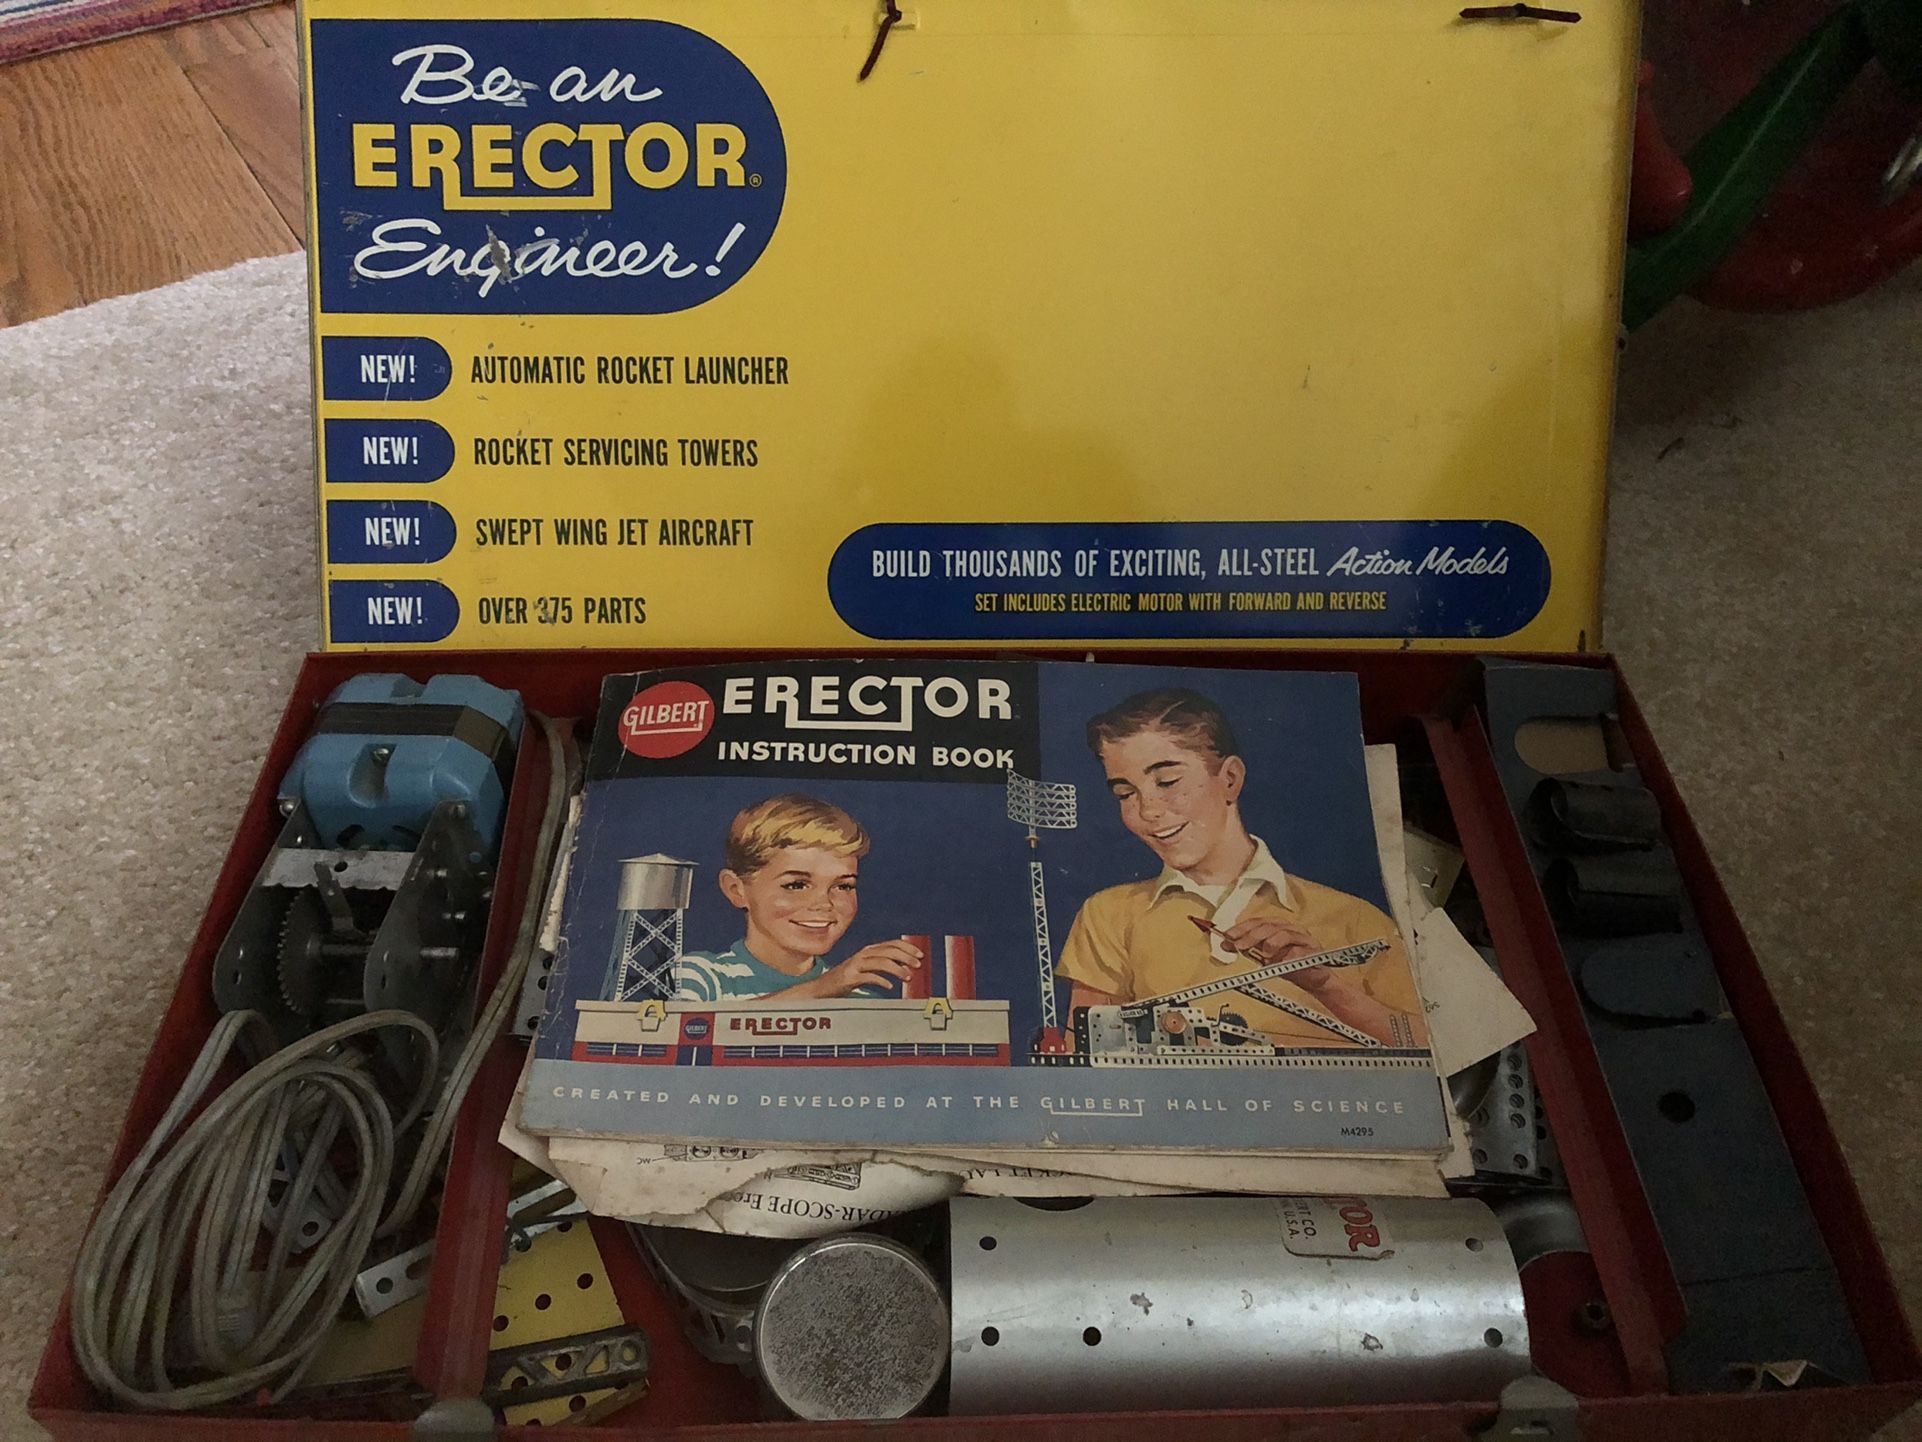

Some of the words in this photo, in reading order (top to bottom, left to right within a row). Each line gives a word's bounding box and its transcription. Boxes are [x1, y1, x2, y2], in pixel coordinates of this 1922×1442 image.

[392, 44, 525, 104] Be
[549, 66, 663, 102] an
[353, 218, 747, 298] Engineer!
[360, 354, 418, 383] NEW!
[471, 356, 586, 384] AUTOMATIC
[597, 356, 674, 385] ROCKET
[684, 356, 790, 385] LAUNCHER
[363, 436, 419, 465] NEW!
[473, 438, 553, 466] ROCKET
[564, 438, 669, 466] SERVICING
[678, 438, 759, 467] TOWERS
[365, 517, 421, 545] NEW!
[475, 518, 544, 546] SWEPT
[554, 518, 608, 546] WING
[617, 518, 649, 546] JET
[658, 518, 754, 546] AIRCRAFT
[872, 550, 931, 577] BUILD
[942, 550, 1062, 577] THOUSANDS
[1074, 549, 1099, 577] OF
[1109, 548, 1206, 580] EXCITING,
[1217, 548, 1320, 576] ALL-STEEL
[1326, 545, 1413, 577] Action
[1415, 545, 1510, 576] Models
[367, 597, 423, 625] NEW!
[478, 598, 528, 624] OVER
[537, 598, 573, 625] 375
[583, 598, 647, 625] PARTS
[975, 593, 999, 612] SET
[1003, 593, 1066, 612] INCLUDES
[1071, 593, 1132, 612] ELECTRIC
[1138, 593, 1184, 612] MOTOR
[1189, 593, 1222, 611] WITH
[1228, 592, 1292, 611] FORWARD
[1296, 592, 1325, 611] AND
[1329, 592, 1387, 611] REVERSE
[622, 700, 710, 736] GILBERT
[722, 675, 1013, 732] ERECTOR
[717, 740, 917, 766] INSTRUCTION
[931, 746, 1015, 769] BOOK
[729, 1017, 832, 1036] ERECTOR
[552, 1086, 670, 1104] CREATED
[689, 1093, 740, 1106] AND
[759, 1095, 906, 1109] DEVELOPED
[925, 1097, 953, 1109] AT
[973, 1096, 1020, 1109] THE
[1040, 1097, 1146, 1117] GILBERT
[1167, 1099, 1228, 1111] HALL
[1244, 1100, 1273, 1112] OF
[1293, 1100, 1405, 1114] SCIENCE
[1340, 1127, 1375, 1138] M4295
